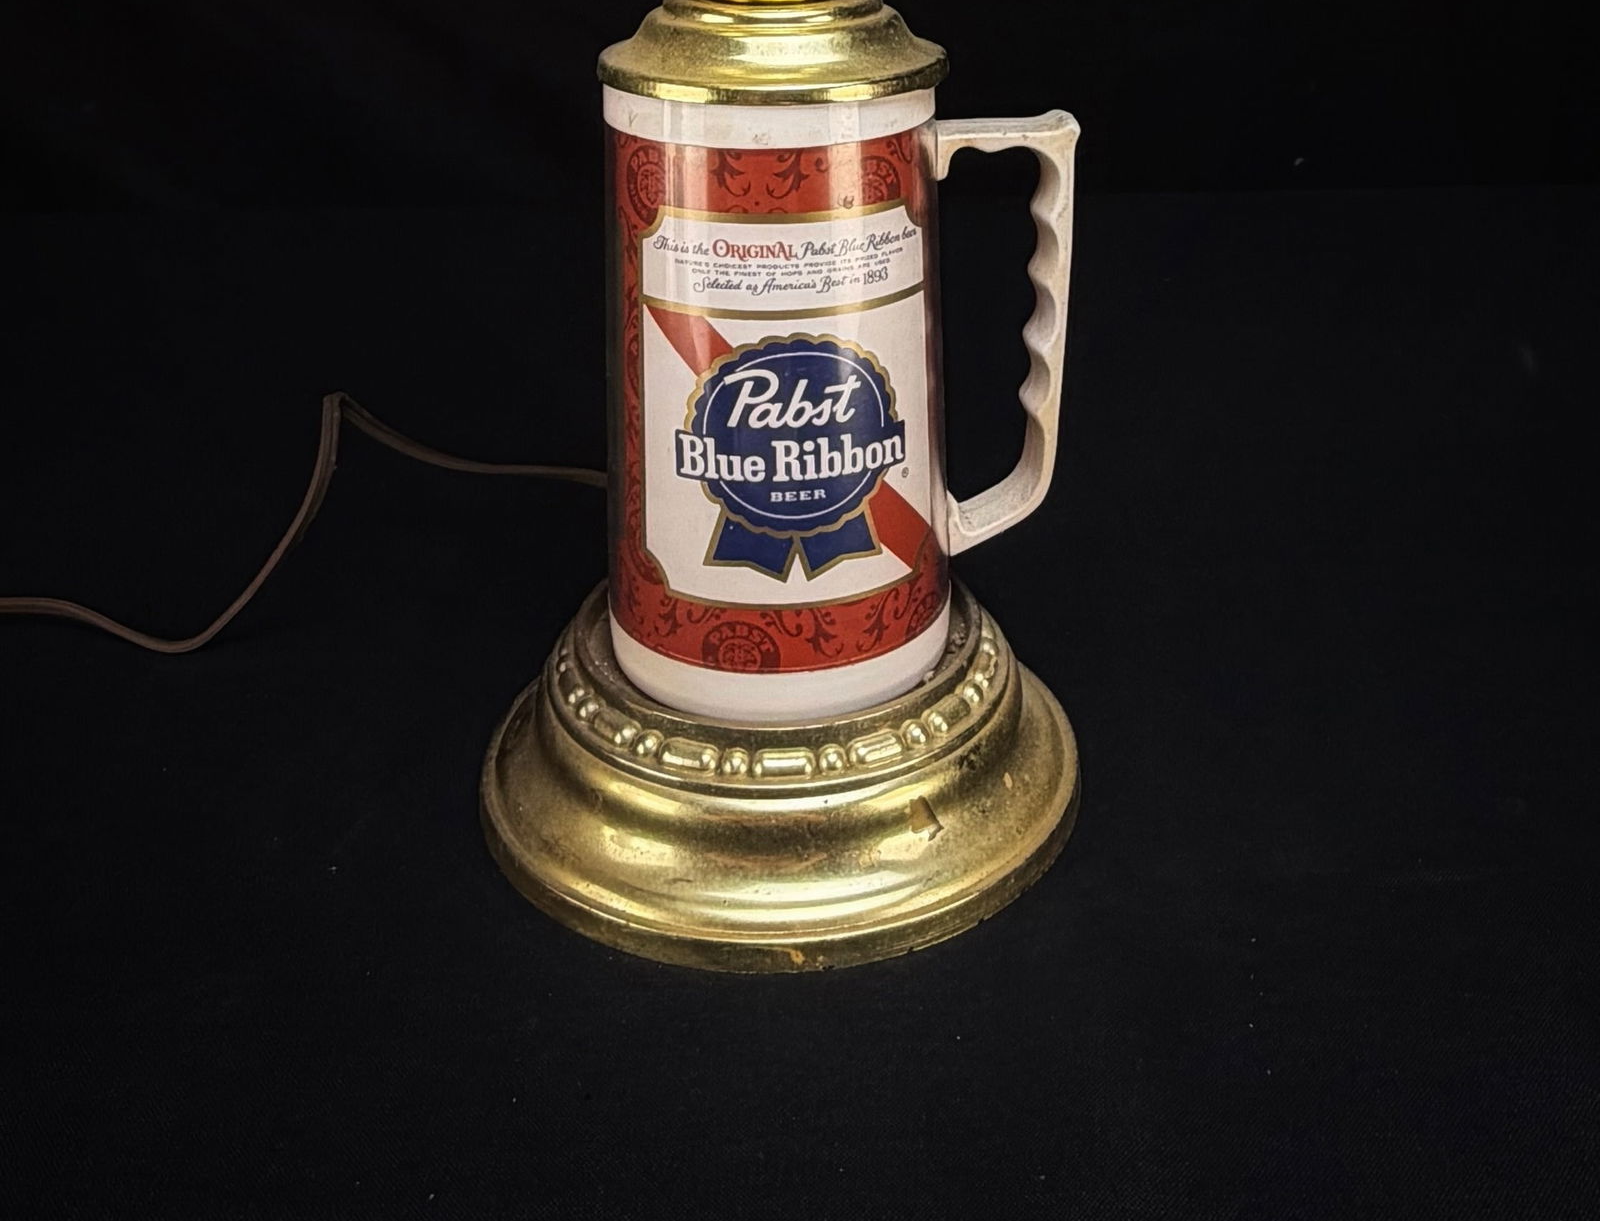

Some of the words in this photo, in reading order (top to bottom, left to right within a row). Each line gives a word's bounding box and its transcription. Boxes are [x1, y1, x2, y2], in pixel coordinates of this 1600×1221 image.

[653, 235, 679, 252] This
[680, 241, 689, 254] is
[692, 241, 710, 256] the
[712, 239, 798, 262] ORIGINAL
[797, 241, 836, 260] Pabst
[834, 238, 864, 257] Blue
[862, 231, 900, 252] Ribbon
[693, 276, 743, 293] Selected
[751, 278, 817, 296] America's
[816, 275, 846, 294] Best
[849, 274, 861, 285] in
[863, 266, 888, 285] 1893
[723, 368, 862, 429] Pabst
[679, 433, 766, 482] Blue
[771, 433, 904, 482] Ribbon
[770, 489, 826, 502] BEER
